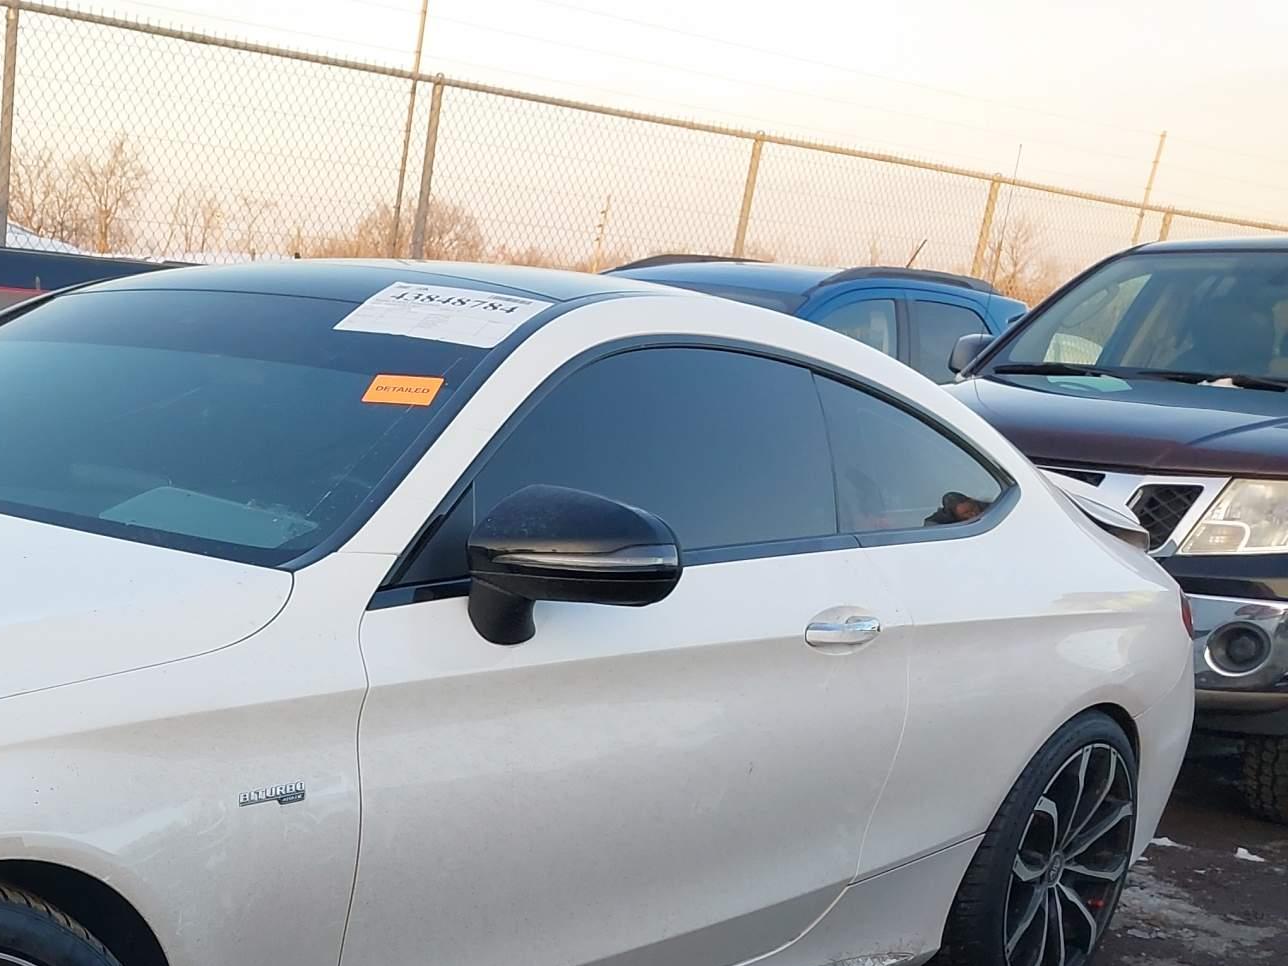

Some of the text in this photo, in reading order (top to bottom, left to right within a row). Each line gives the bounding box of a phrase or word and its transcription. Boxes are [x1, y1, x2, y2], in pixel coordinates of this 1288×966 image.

[390, 291, 520, 314] 43848784
[375, 385, 430, 394] DETAILED
[239, 780, 305, 803] BITURBO
